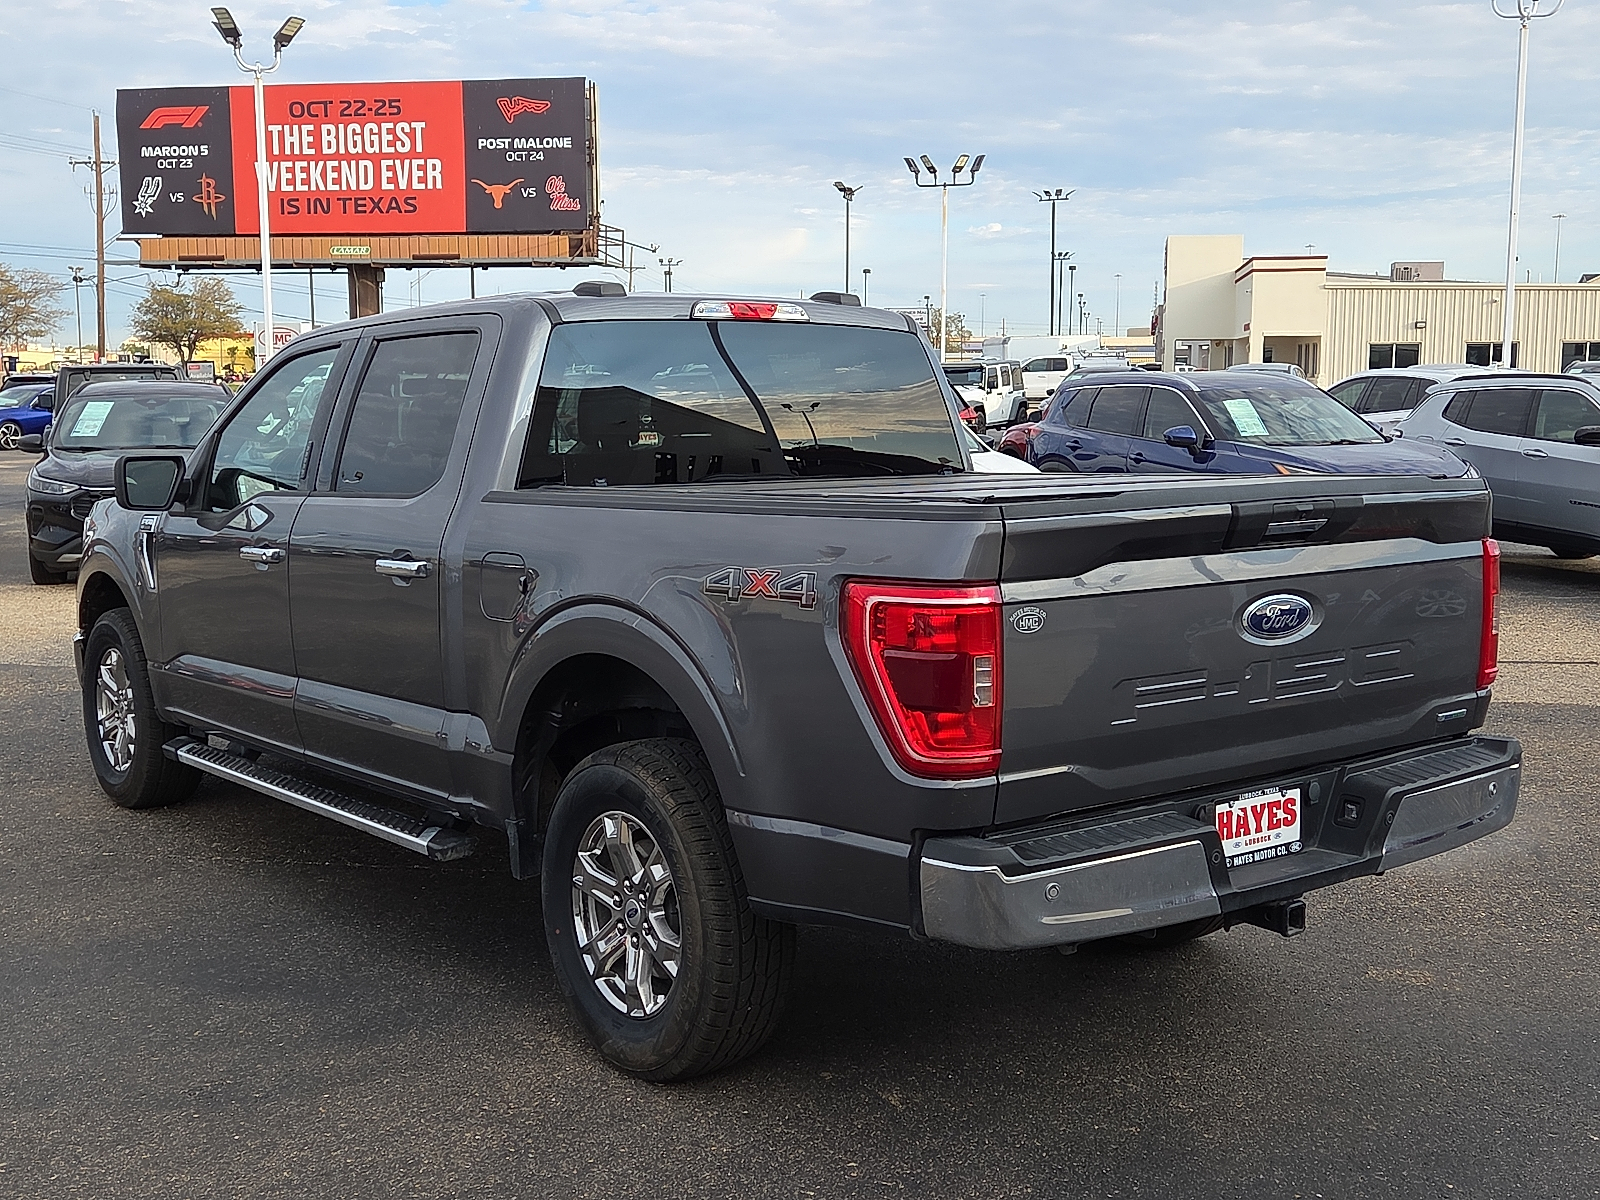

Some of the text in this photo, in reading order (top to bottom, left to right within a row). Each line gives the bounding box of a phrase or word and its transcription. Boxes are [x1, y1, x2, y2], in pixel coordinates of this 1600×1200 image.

[288, 97, 402, 118] OCT 22-25
[267, 121, 426, 155] THE BIGGEST
[478, 136, 572, 150] POST MALONE
[140, 144, 209, 158] MAROON 5
[506, 151, 545, 162] OCT 24
[157, 158, 193, 170] OCT 23
[254, 158, 443, 192] WEEKEND EVER
[545, 175, 566, 194] Ole
[169, 192, 185, 203] VS
[521, 187, 537, 198] VS
[550, 192, 581, 211] Miss
[280, 196, 418, 215] IS IN TEXAS
[1019, 615, 1039, 630] HMC
[1262, 603, 1301, 631] Ford
[1110, 640, 1416, 726] F-150
[1264, 786, 1280, 796] TEXAS
[1217, 797, 1297, 841] HAYES
[1233, 853, 1254, 867] HAYES
[1254, 848, 1277, 861] MOTOR
[1276, 845, 1288, 856] CO.
